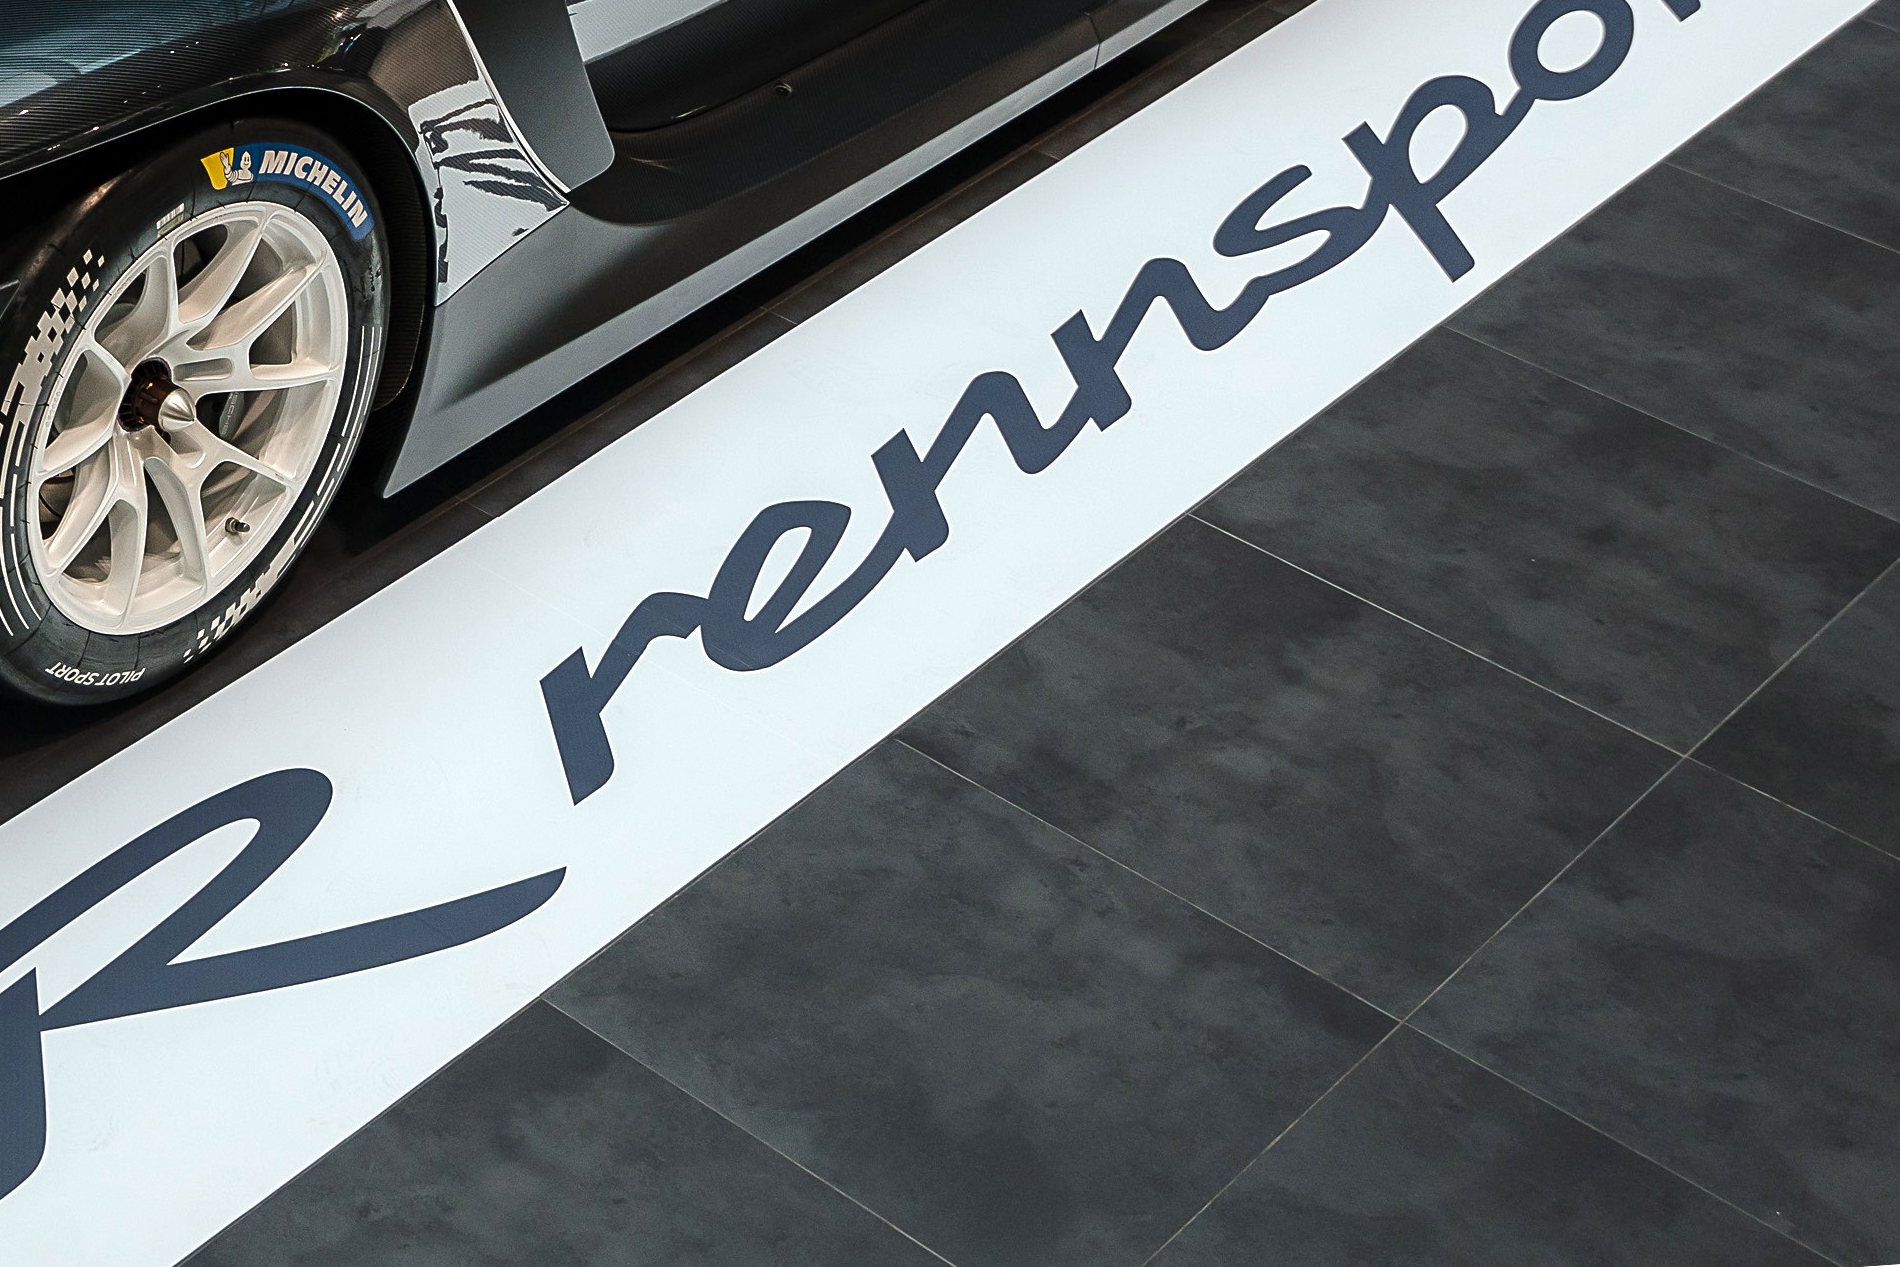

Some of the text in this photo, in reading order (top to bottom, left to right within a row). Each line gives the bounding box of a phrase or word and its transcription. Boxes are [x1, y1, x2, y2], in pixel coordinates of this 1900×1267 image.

[259, 150, 368, 228] MICHELIN
[44, 661, 146, 686] PILOT SPORT
